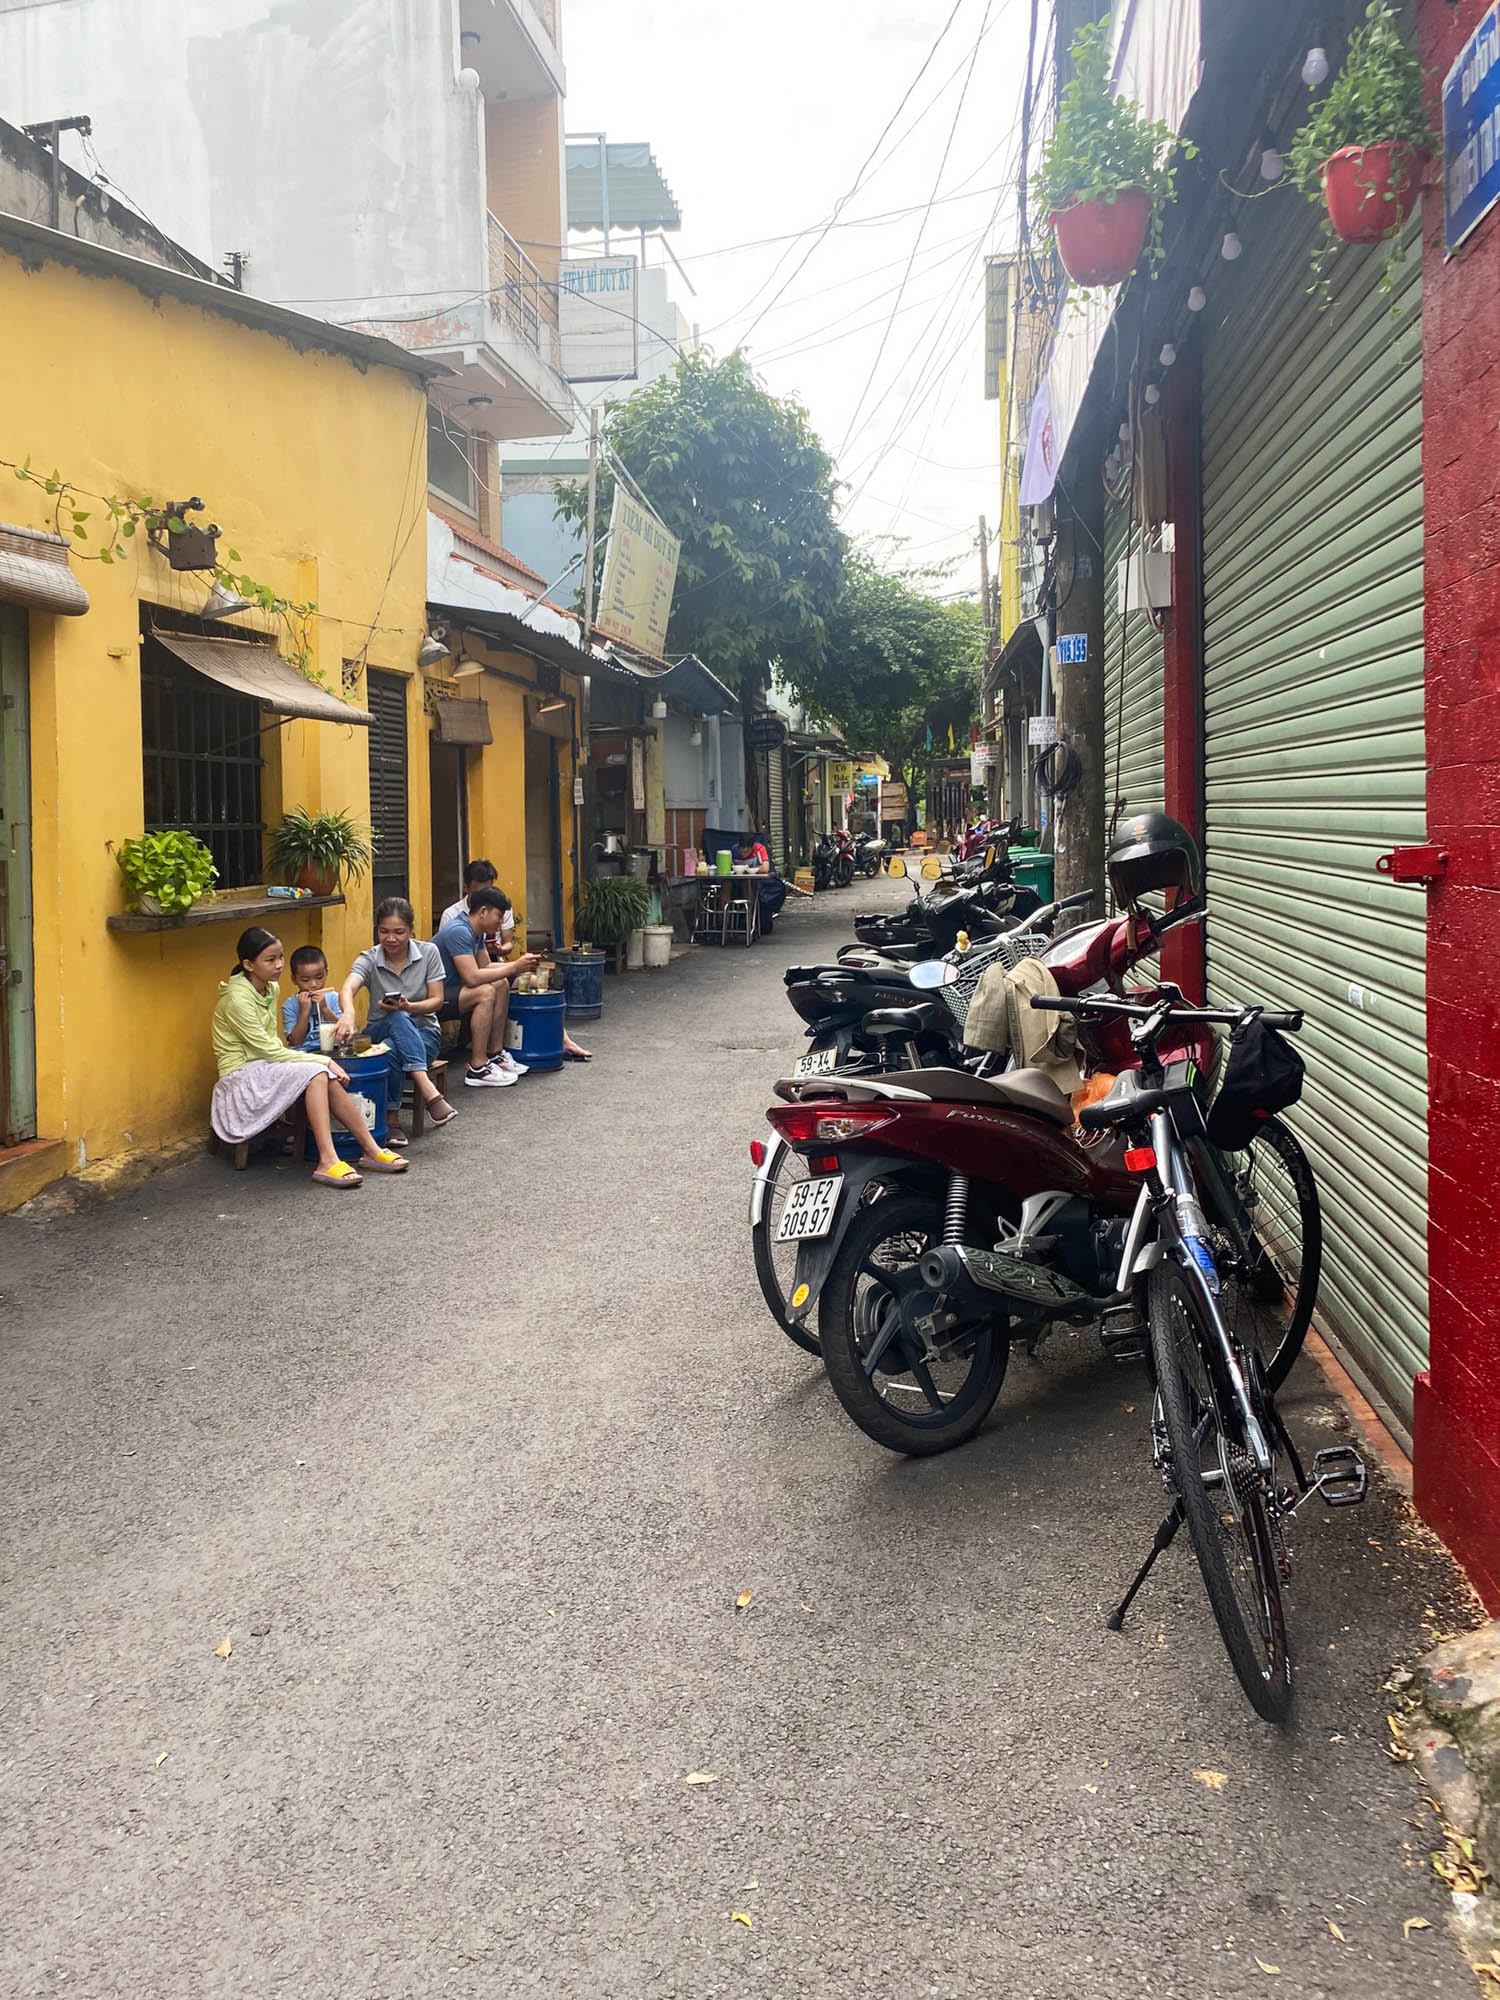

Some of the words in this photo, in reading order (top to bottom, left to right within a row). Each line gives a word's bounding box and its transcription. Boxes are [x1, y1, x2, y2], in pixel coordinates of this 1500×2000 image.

[800, 1051, 831, 1073] 59-X4
[791, 1180, 834, 1209] 59-F2
[780, 1207, 830, 1238] 309.97
